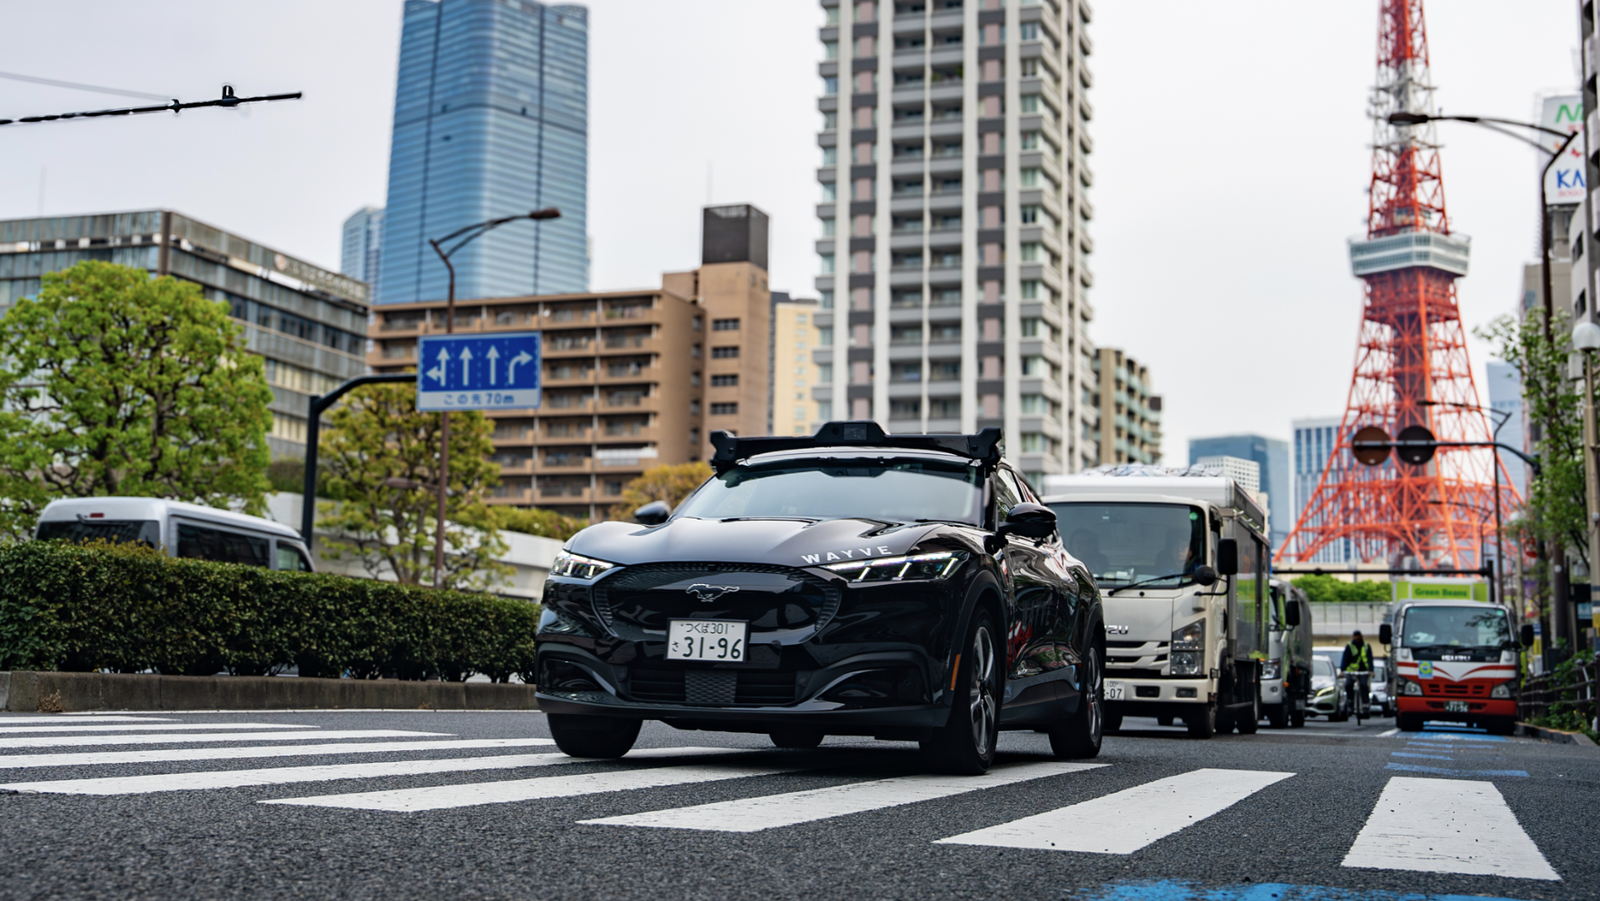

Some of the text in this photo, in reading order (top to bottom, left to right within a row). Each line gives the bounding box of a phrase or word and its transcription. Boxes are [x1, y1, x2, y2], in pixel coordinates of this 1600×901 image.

[801, 545, 893, 564] WAYVE
[1415, 588, 1467, 597] Green Beans
[1104, 624, 1129, 635] ZU
[682, 636, 742, 660] 31-96
[1103, 688, 1123, 699] -07
